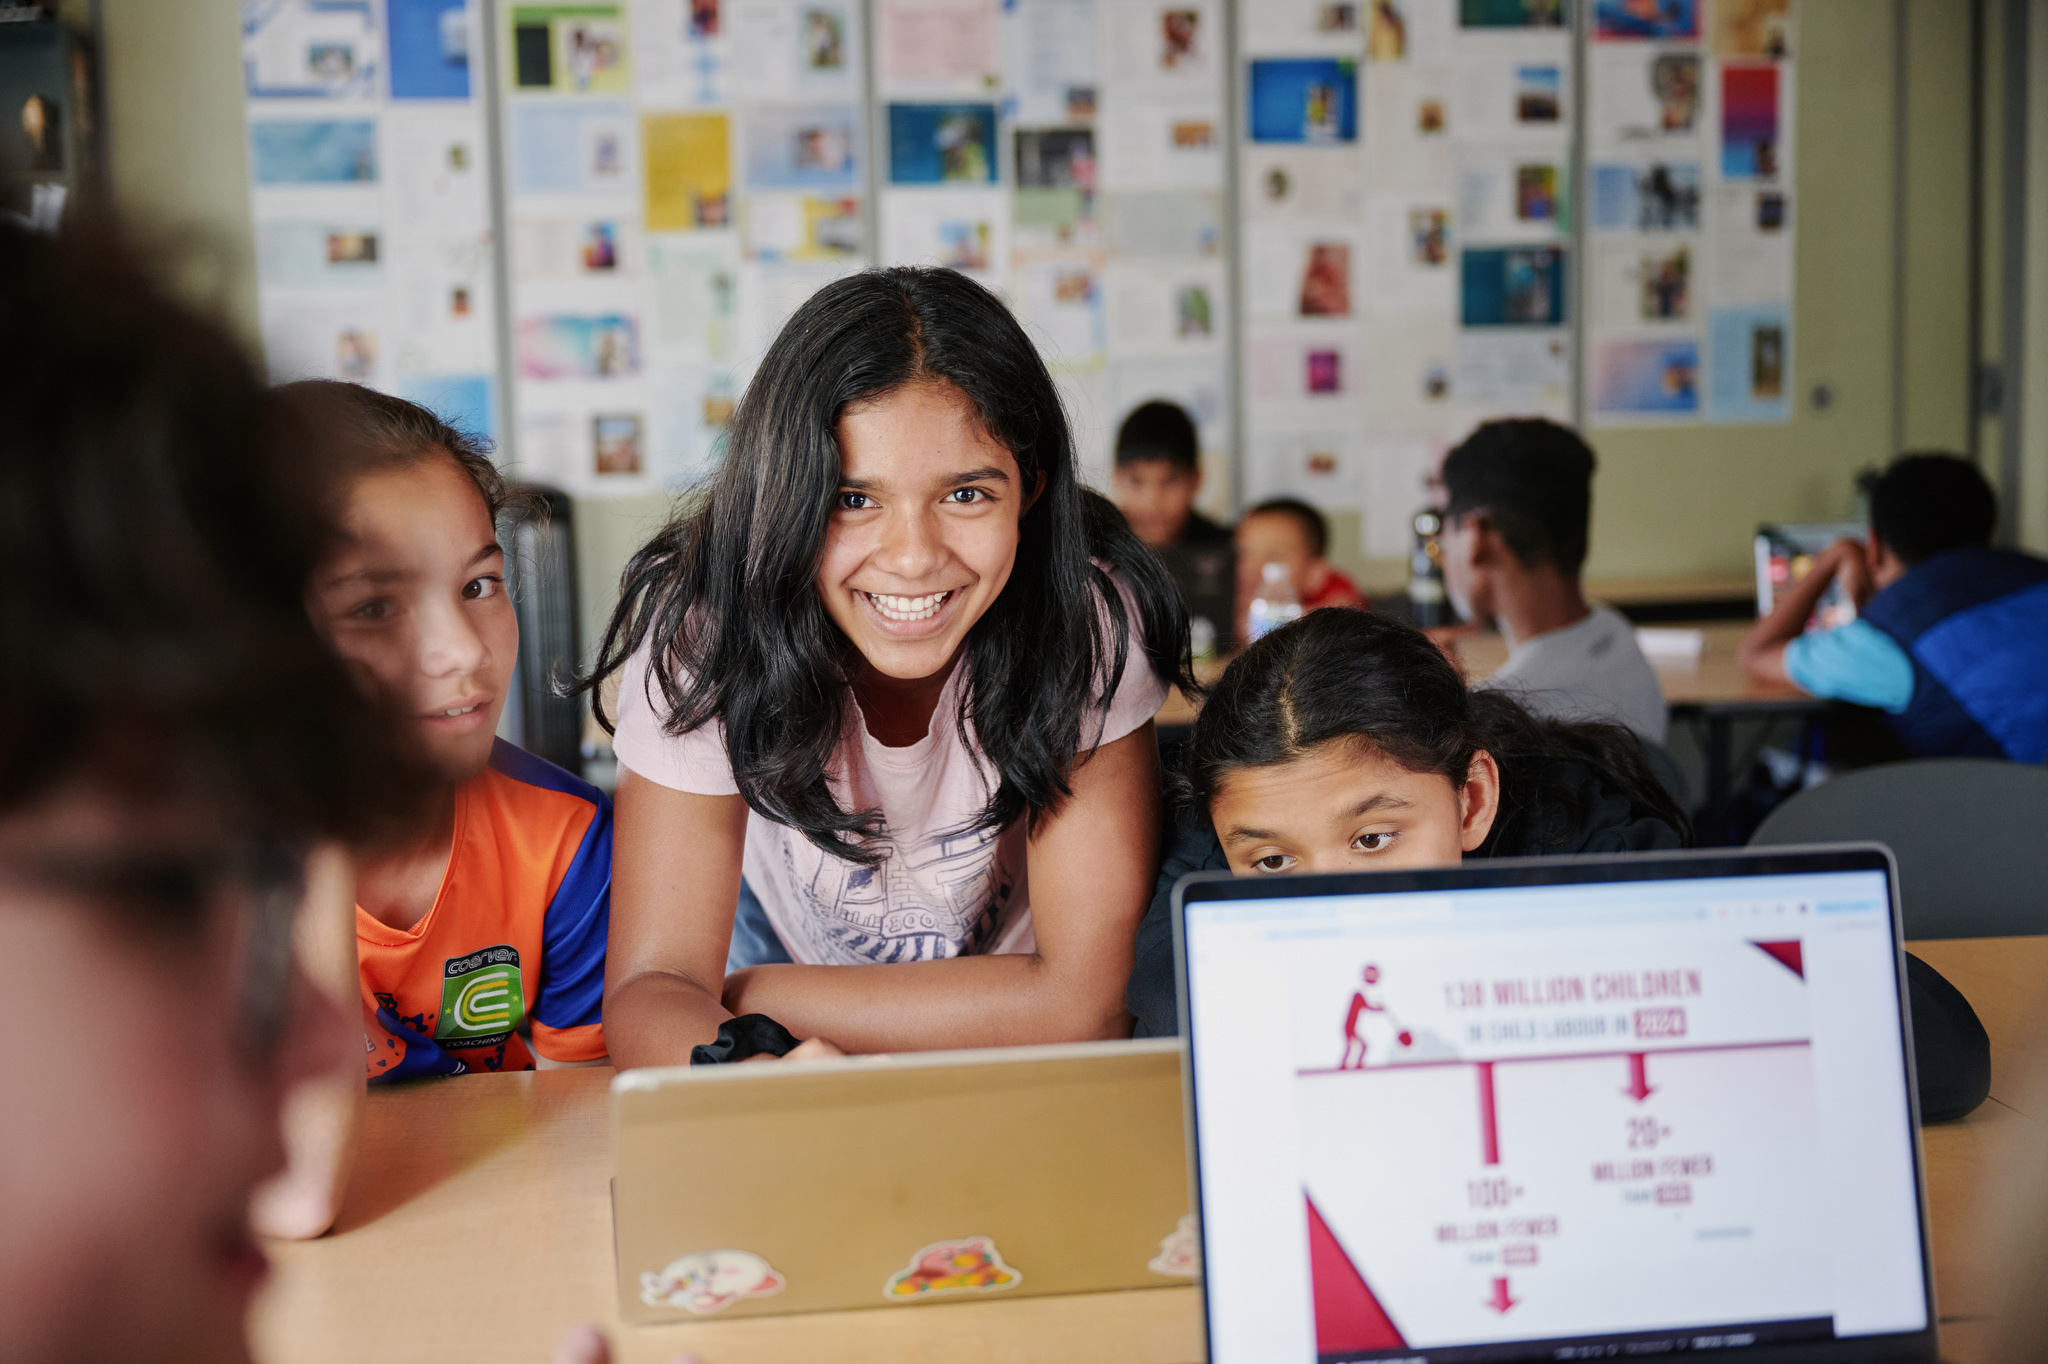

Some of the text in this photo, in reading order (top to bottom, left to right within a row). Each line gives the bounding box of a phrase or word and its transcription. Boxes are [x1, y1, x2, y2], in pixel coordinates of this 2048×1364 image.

[1494, 976, 1585, 1005] MILLION
[1591, 968, 1702, 1001] CHILDREN
[446, 1034, 506, 1048] COACHING
